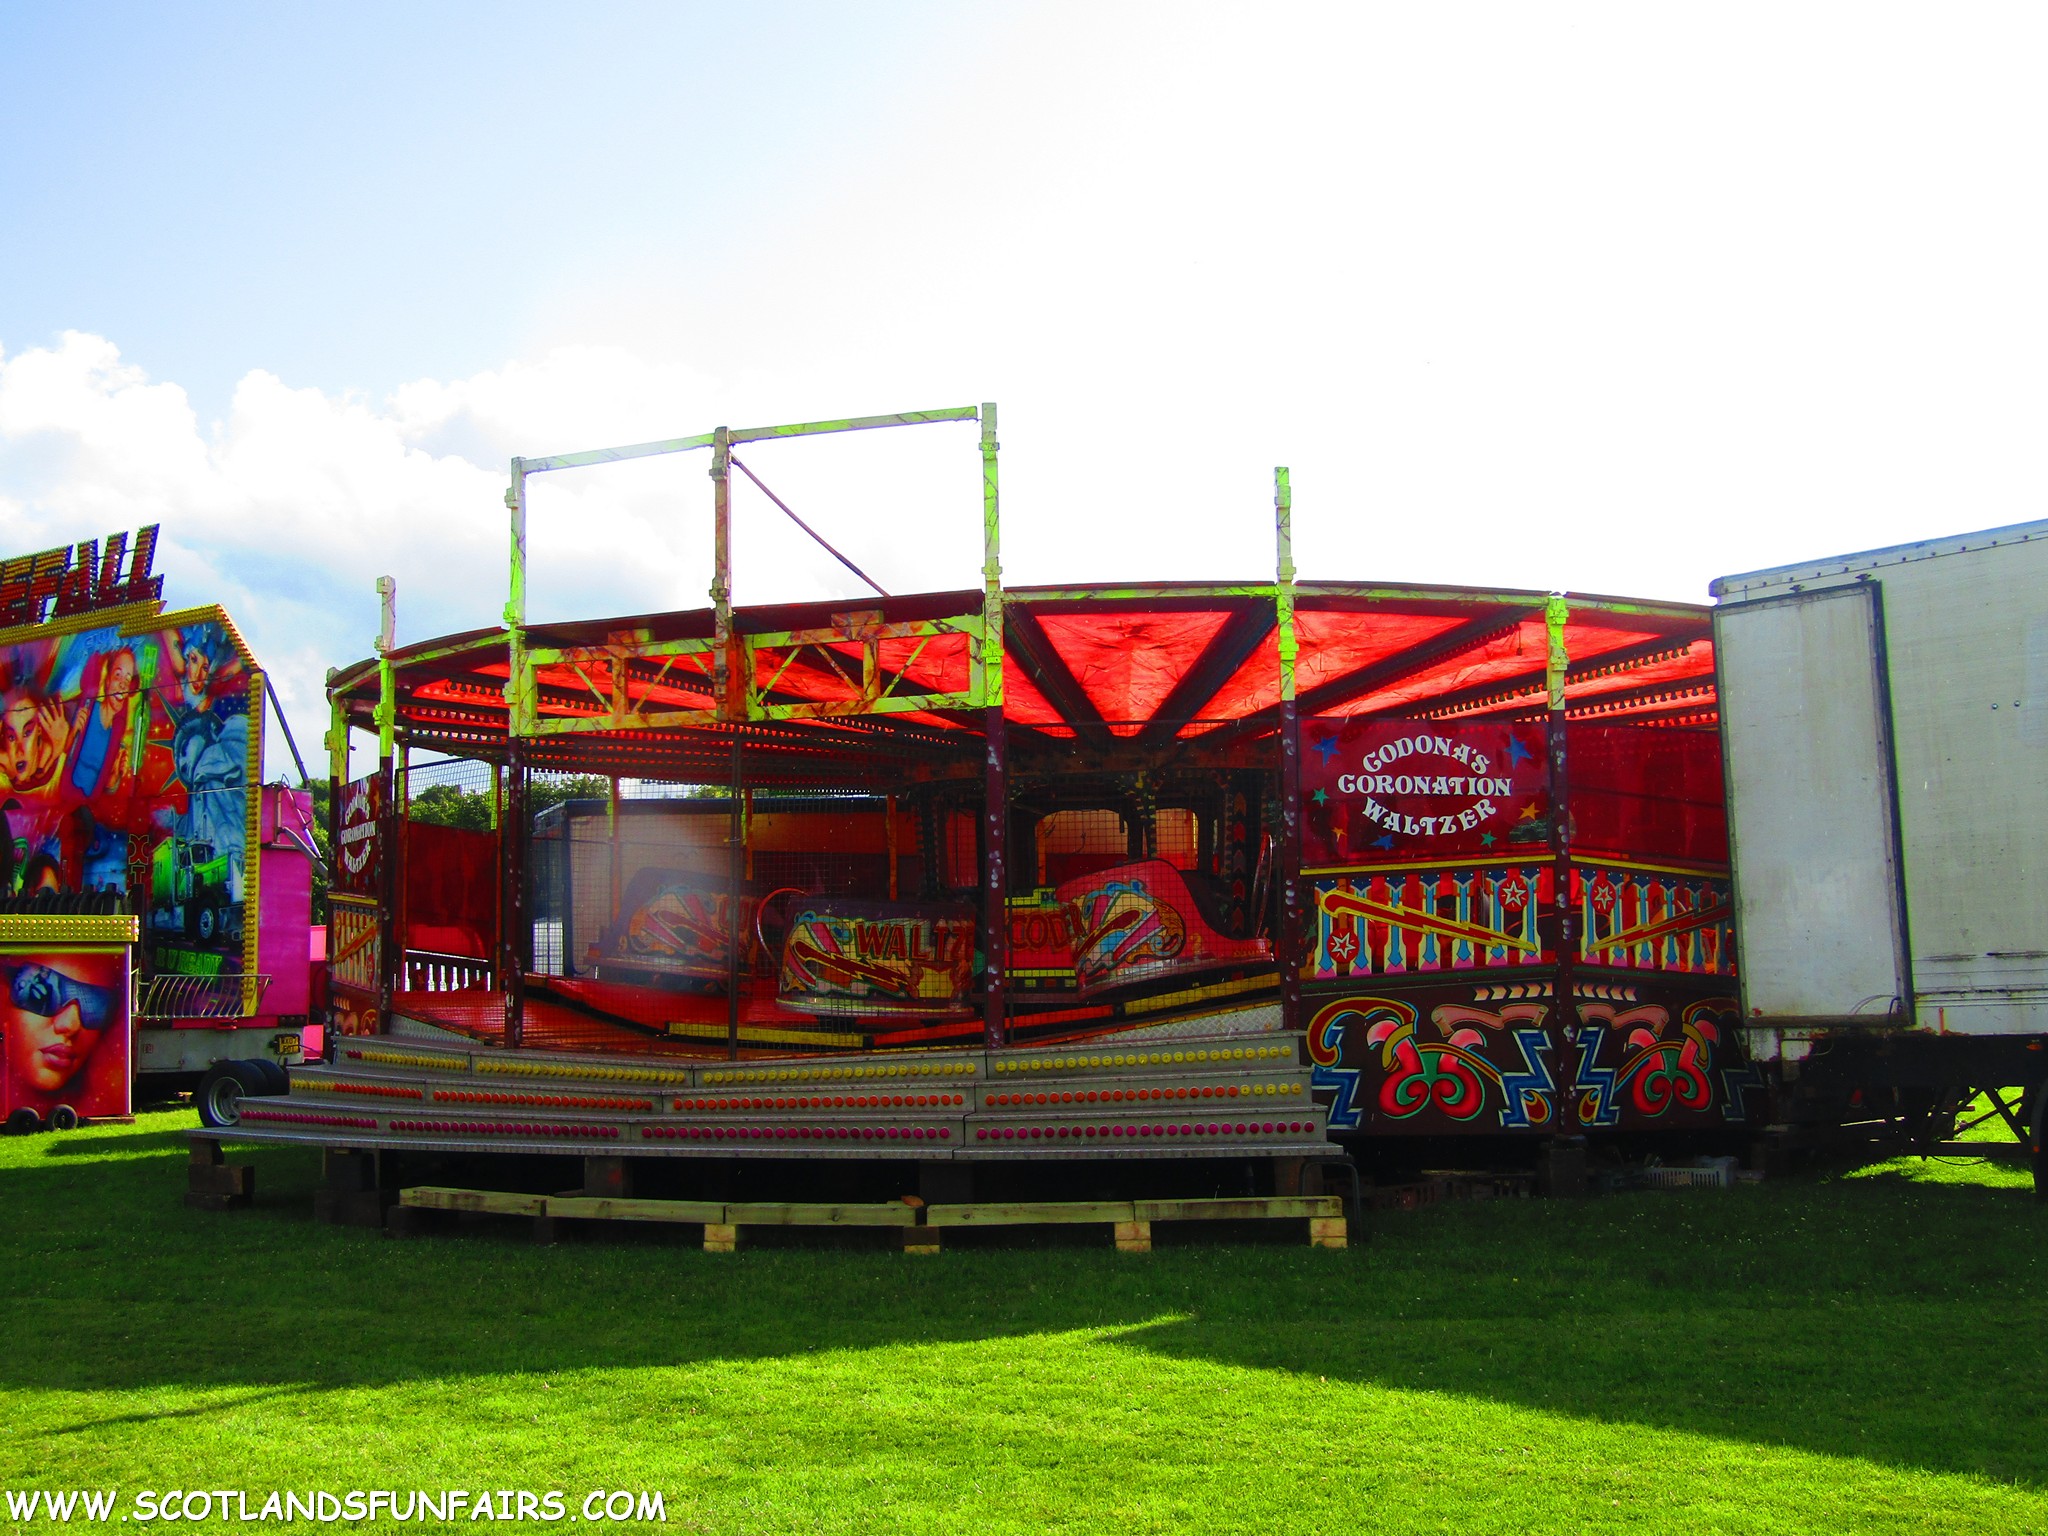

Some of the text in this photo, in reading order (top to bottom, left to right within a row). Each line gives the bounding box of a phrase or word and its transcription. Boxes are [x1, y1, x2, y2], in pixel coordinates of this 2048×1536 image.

[0, 523, 164, 627] EFALL
[1363, 735, 1490, 775] CODONA'S
[1338, 774, 1512, 797] CORONATION
[1362, 797, 1497, 836] WALTZER
[177, 950, 223, 975] READY
